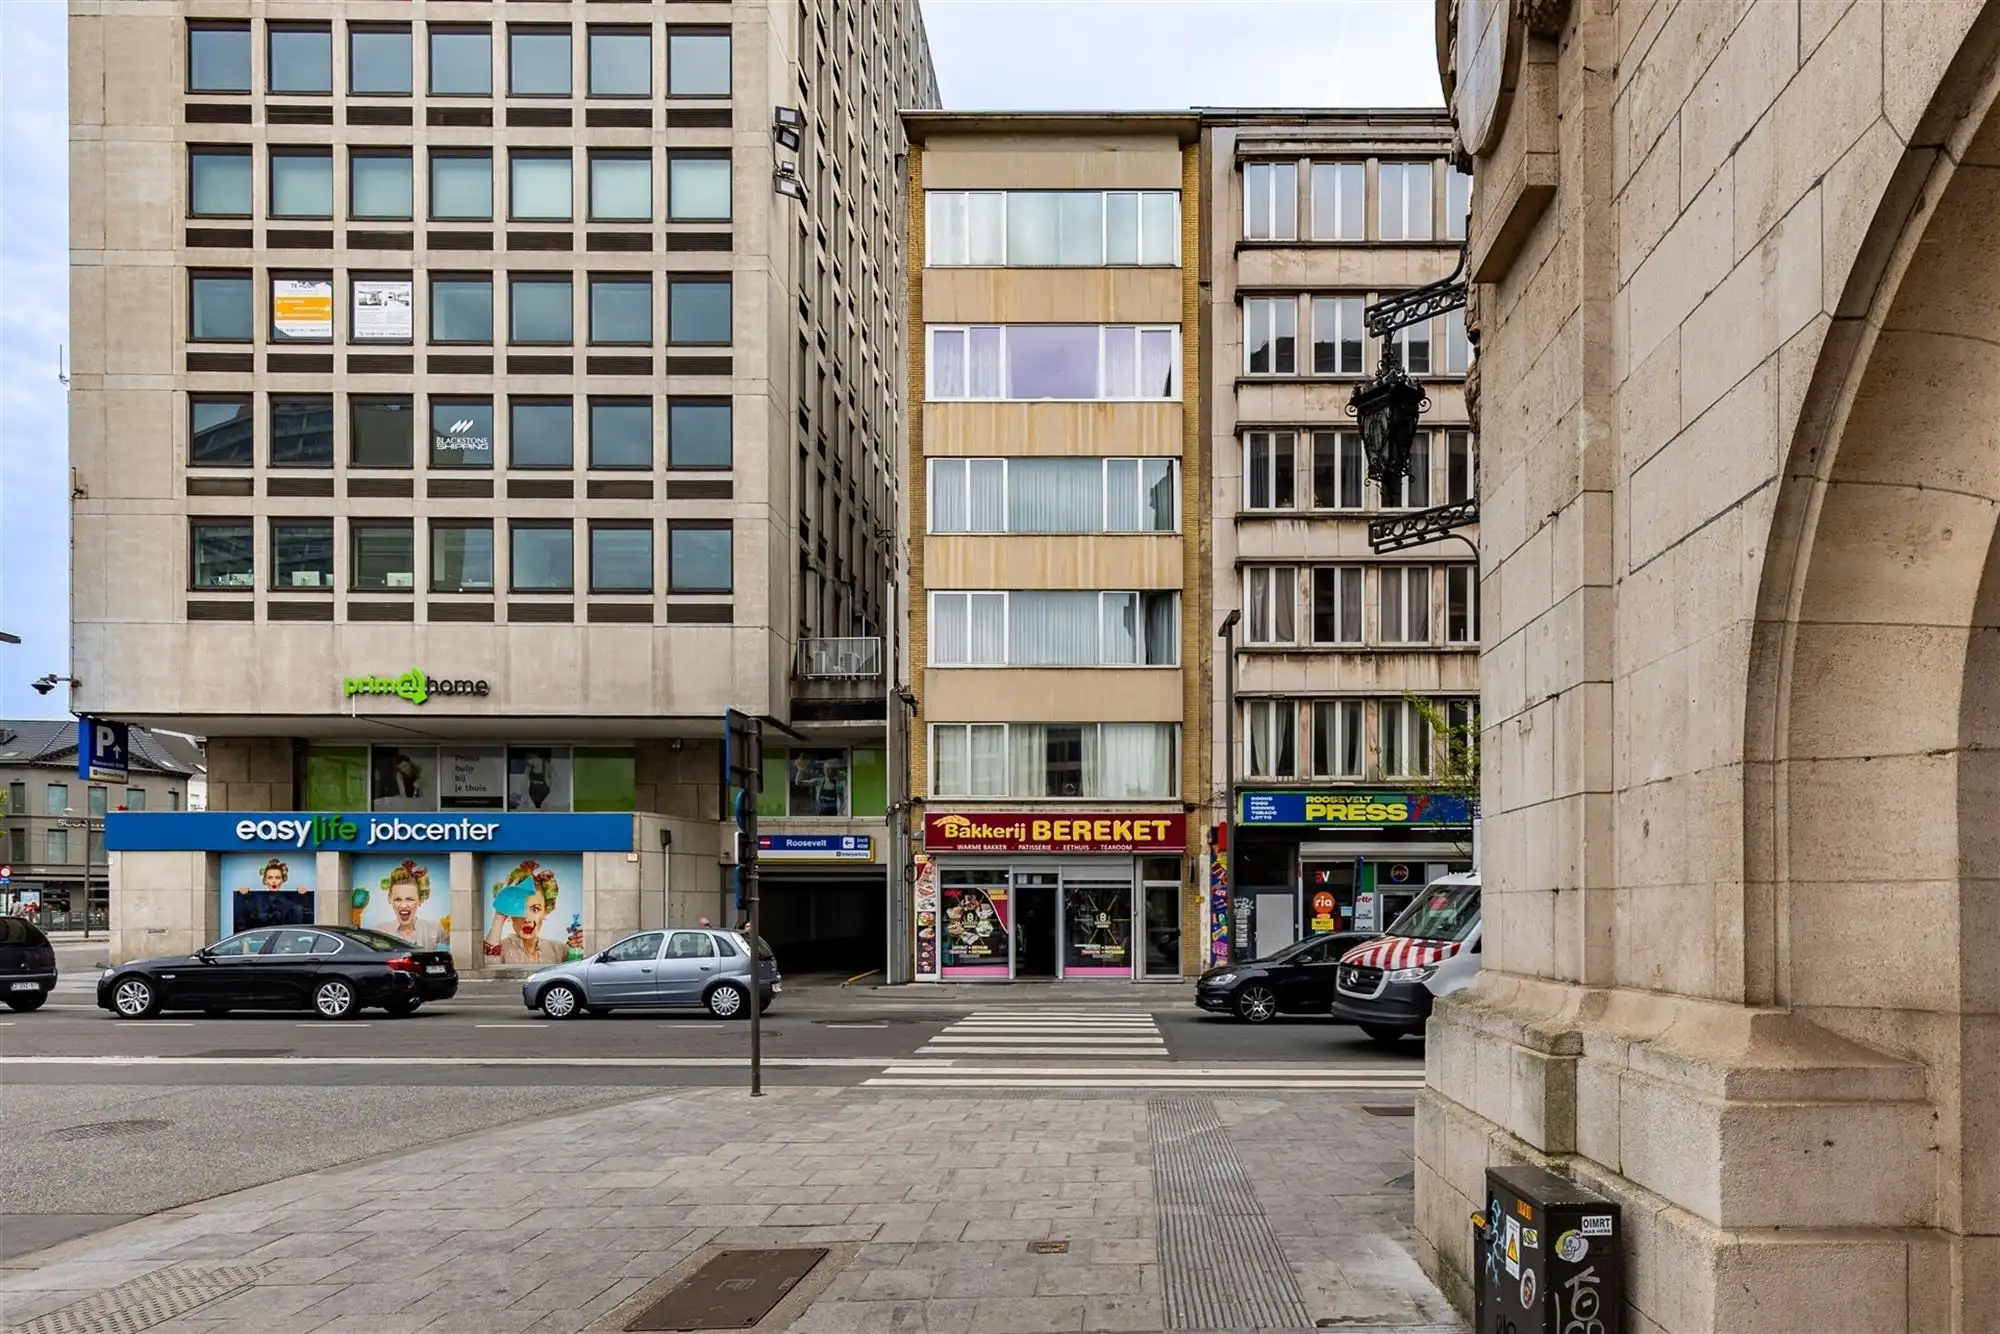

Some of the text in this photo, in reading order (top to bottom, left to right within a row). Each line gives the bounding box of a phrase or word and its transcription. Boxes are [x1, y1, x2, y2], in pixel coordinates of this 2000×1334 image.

[436, 436, 488, 444] BLACKSTONE
[96, 726, 115, 757] P
[1306, 804, 1408, 821] PRESS
[367, 818, 499, 845] jobcenter
[944, 820, 1171, 842] Bakkerij BEREKET
[786, 839, 827, 847] Roosevelt
[1315, 895, 1332, 907] ria
[1583, 1218, 1611, 1228] OIMRT
